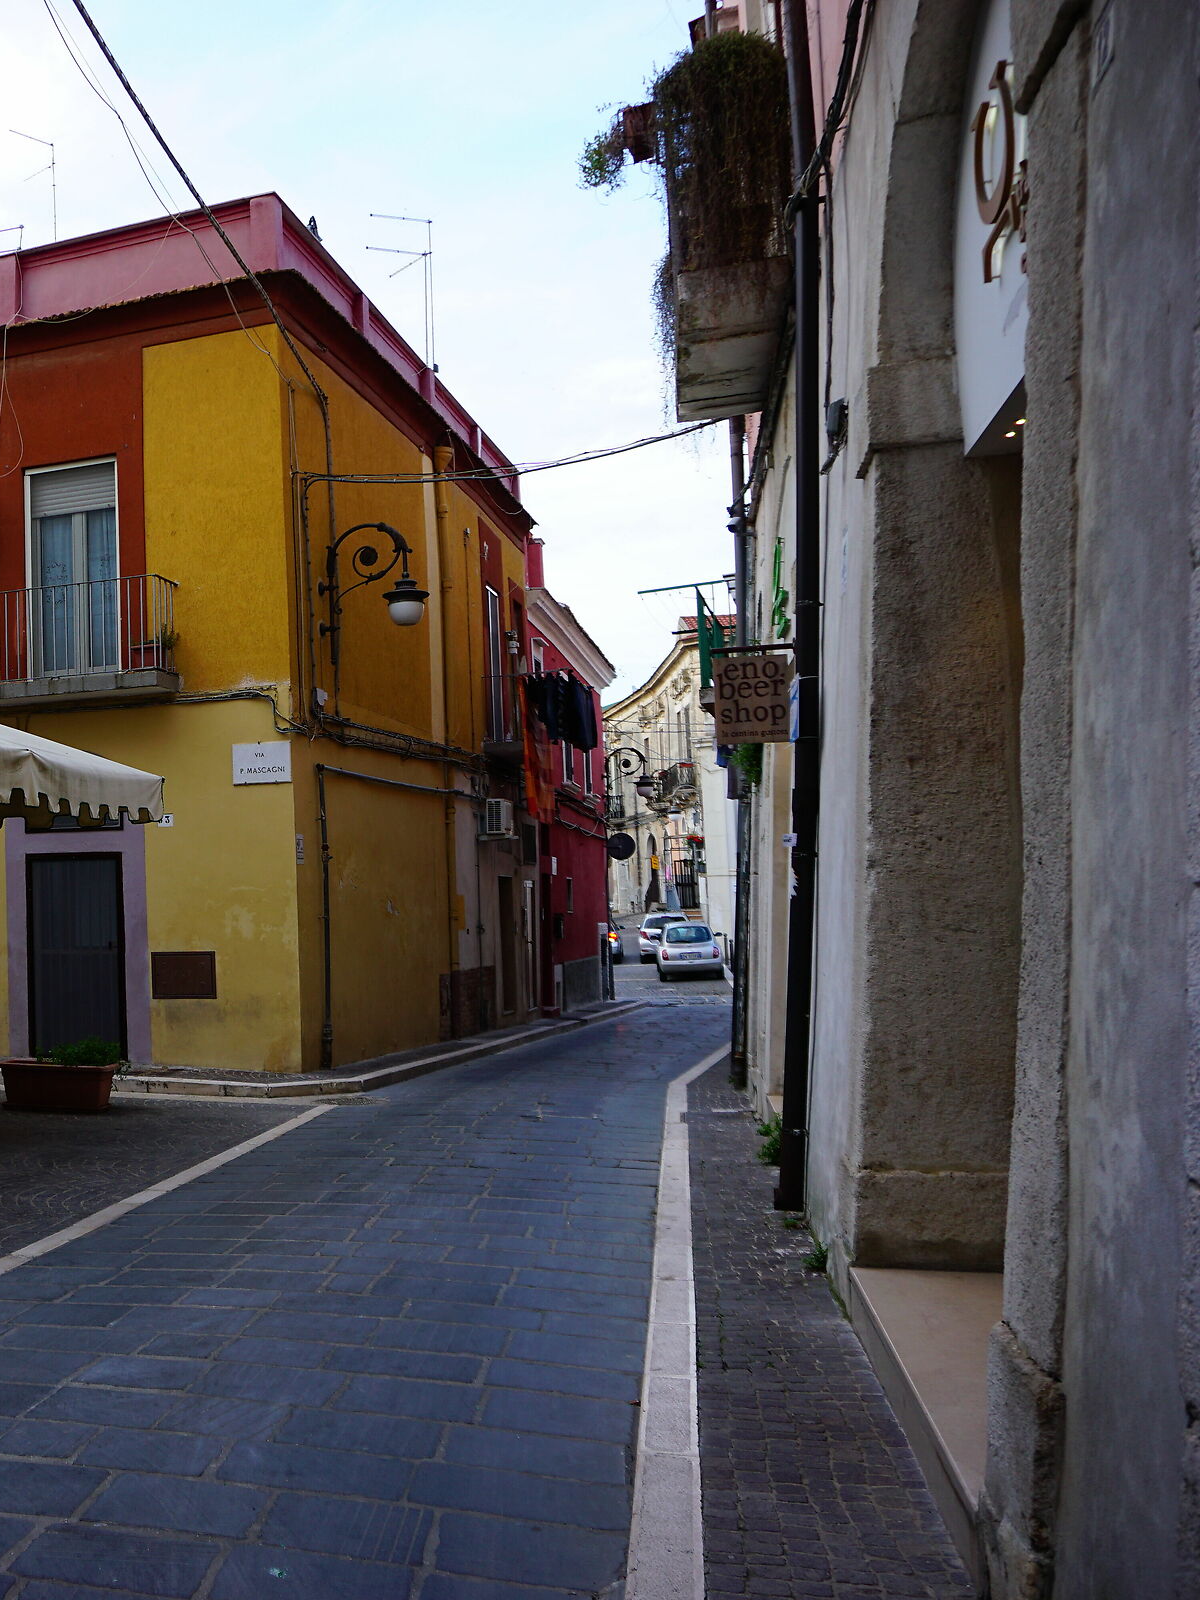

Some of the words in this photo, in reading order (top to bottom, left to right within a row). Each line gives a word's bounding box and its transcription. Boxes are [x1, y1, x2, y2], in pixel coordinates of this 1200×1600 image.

[717, 673, 786, 700] beer
[721, 700, 786, 726] shop
[246, 766, 286, 775] MASCAGNI
